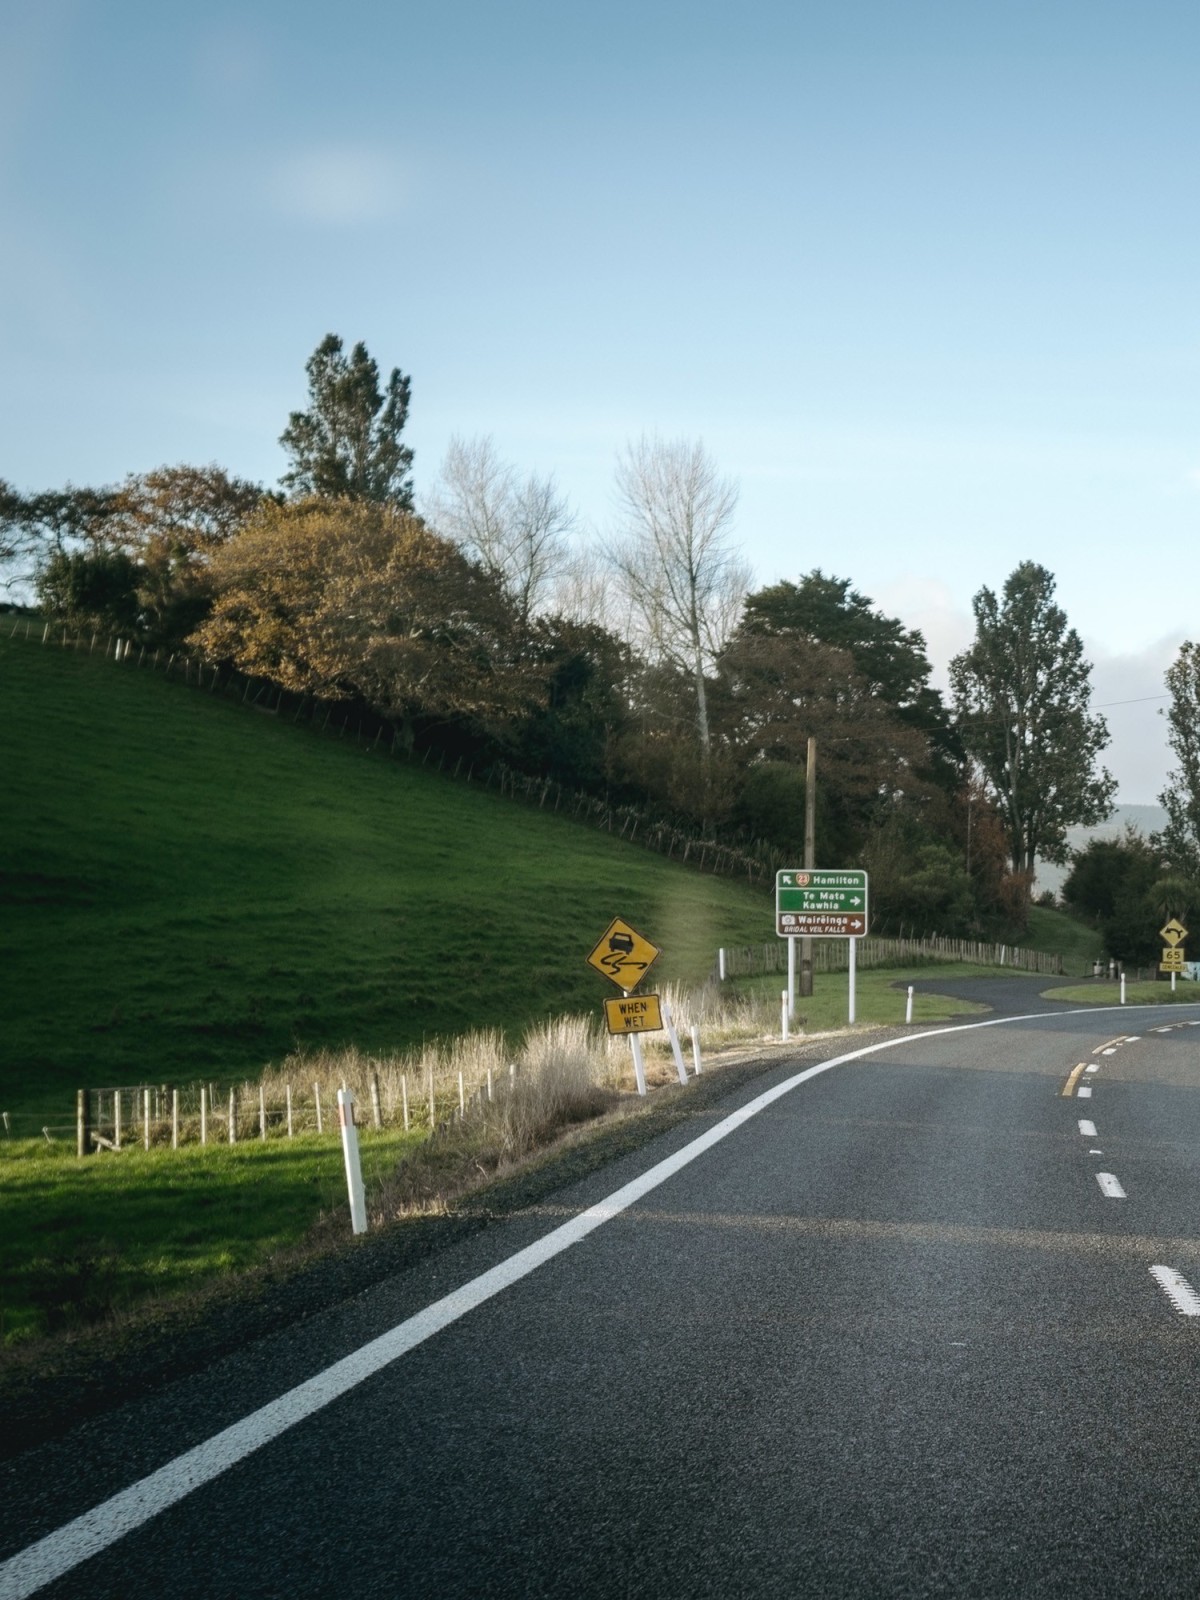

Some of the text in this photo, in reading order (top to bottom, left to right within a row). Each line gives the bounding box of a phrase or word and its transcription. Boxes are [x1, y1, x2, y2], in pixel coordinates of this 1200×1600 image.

[814, 876, 859, 884] Hamilton
[803, 892, 815, 900] Te
[1166, 951, 1180, 959] 65
[619, 1002, 647, 1015] WHEN
[624, 1016, 644, 1027] WET
